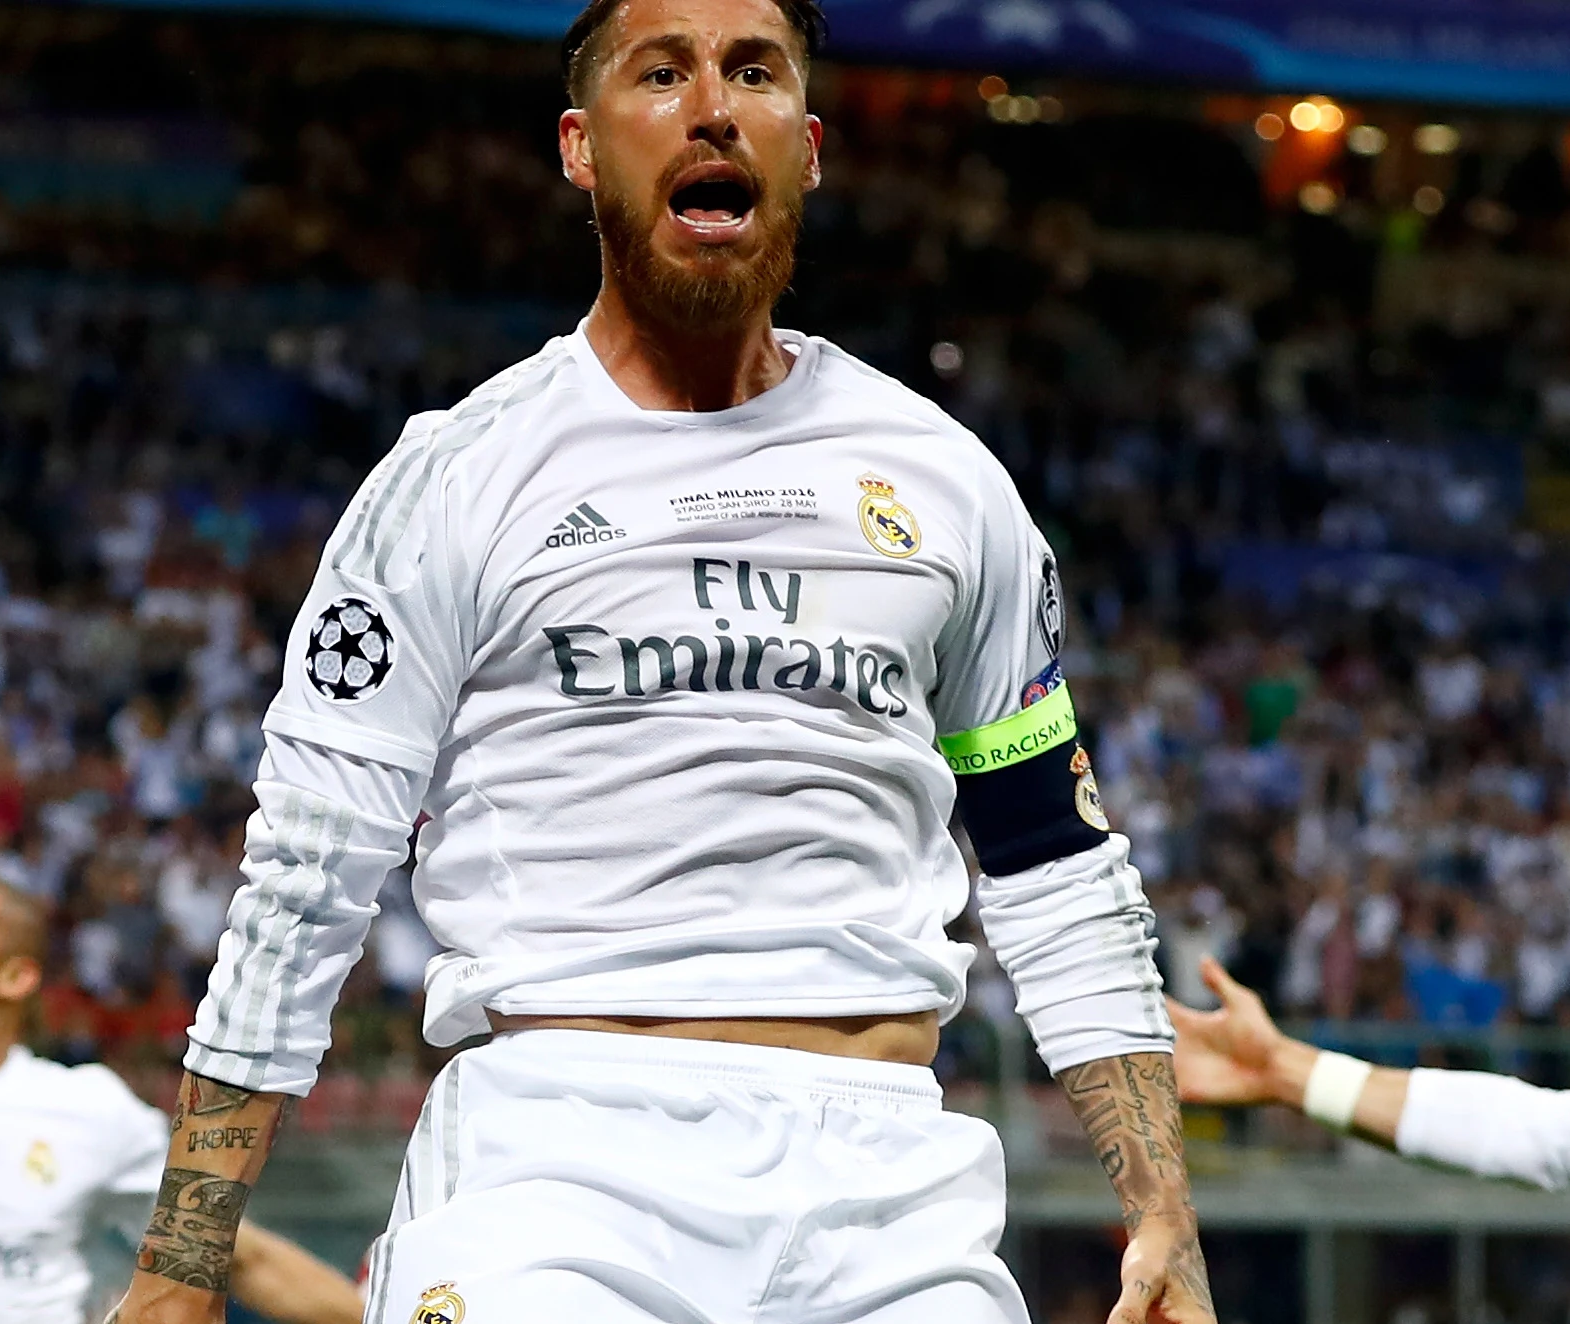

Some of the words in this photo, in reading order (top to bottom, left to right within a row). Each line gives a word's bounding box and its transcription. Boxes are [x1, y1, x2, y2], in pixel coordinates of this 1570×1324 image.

[669, 492, 714, 506] FINAL
[716, 489, 775, 499] MILANO
[779, 488, 815, 497] 2016
[674, 502, 716, 515] STADIO
[717, 501, 741, 510] SAN
[743, 499, 770, 508] SIRO
[780, 498, 793, 508] 28
[795, 499, 817, 508] MAY
[545, 526, 627, 549] adidas
[692, 557, 802, 624] Fly
[542, 617, 910, 718] Emirates
[960, 753, 986, 771] TO
[990, 720, 1062, 764] RACISM
[188, 1127, 258, 1153] HOPE
